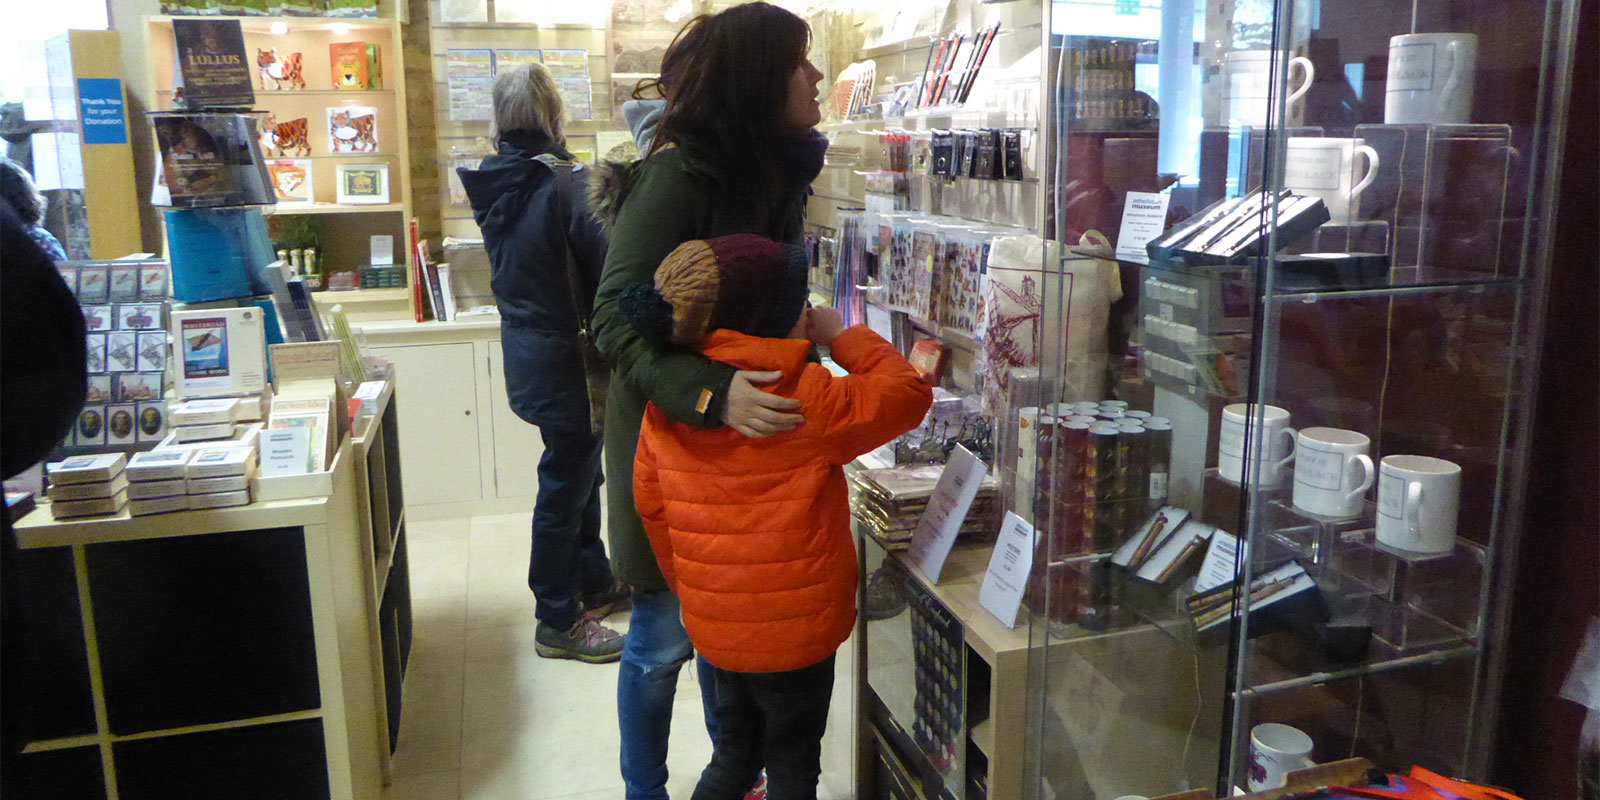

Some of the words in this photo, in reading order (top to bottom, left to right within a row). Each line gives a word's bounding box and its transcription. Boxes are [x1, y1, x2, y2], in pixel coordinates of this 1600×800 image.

[188, 53, 241, 66] LULLUS
[87, 107, 98, 115] for
[100, 108, 117, 116] your
